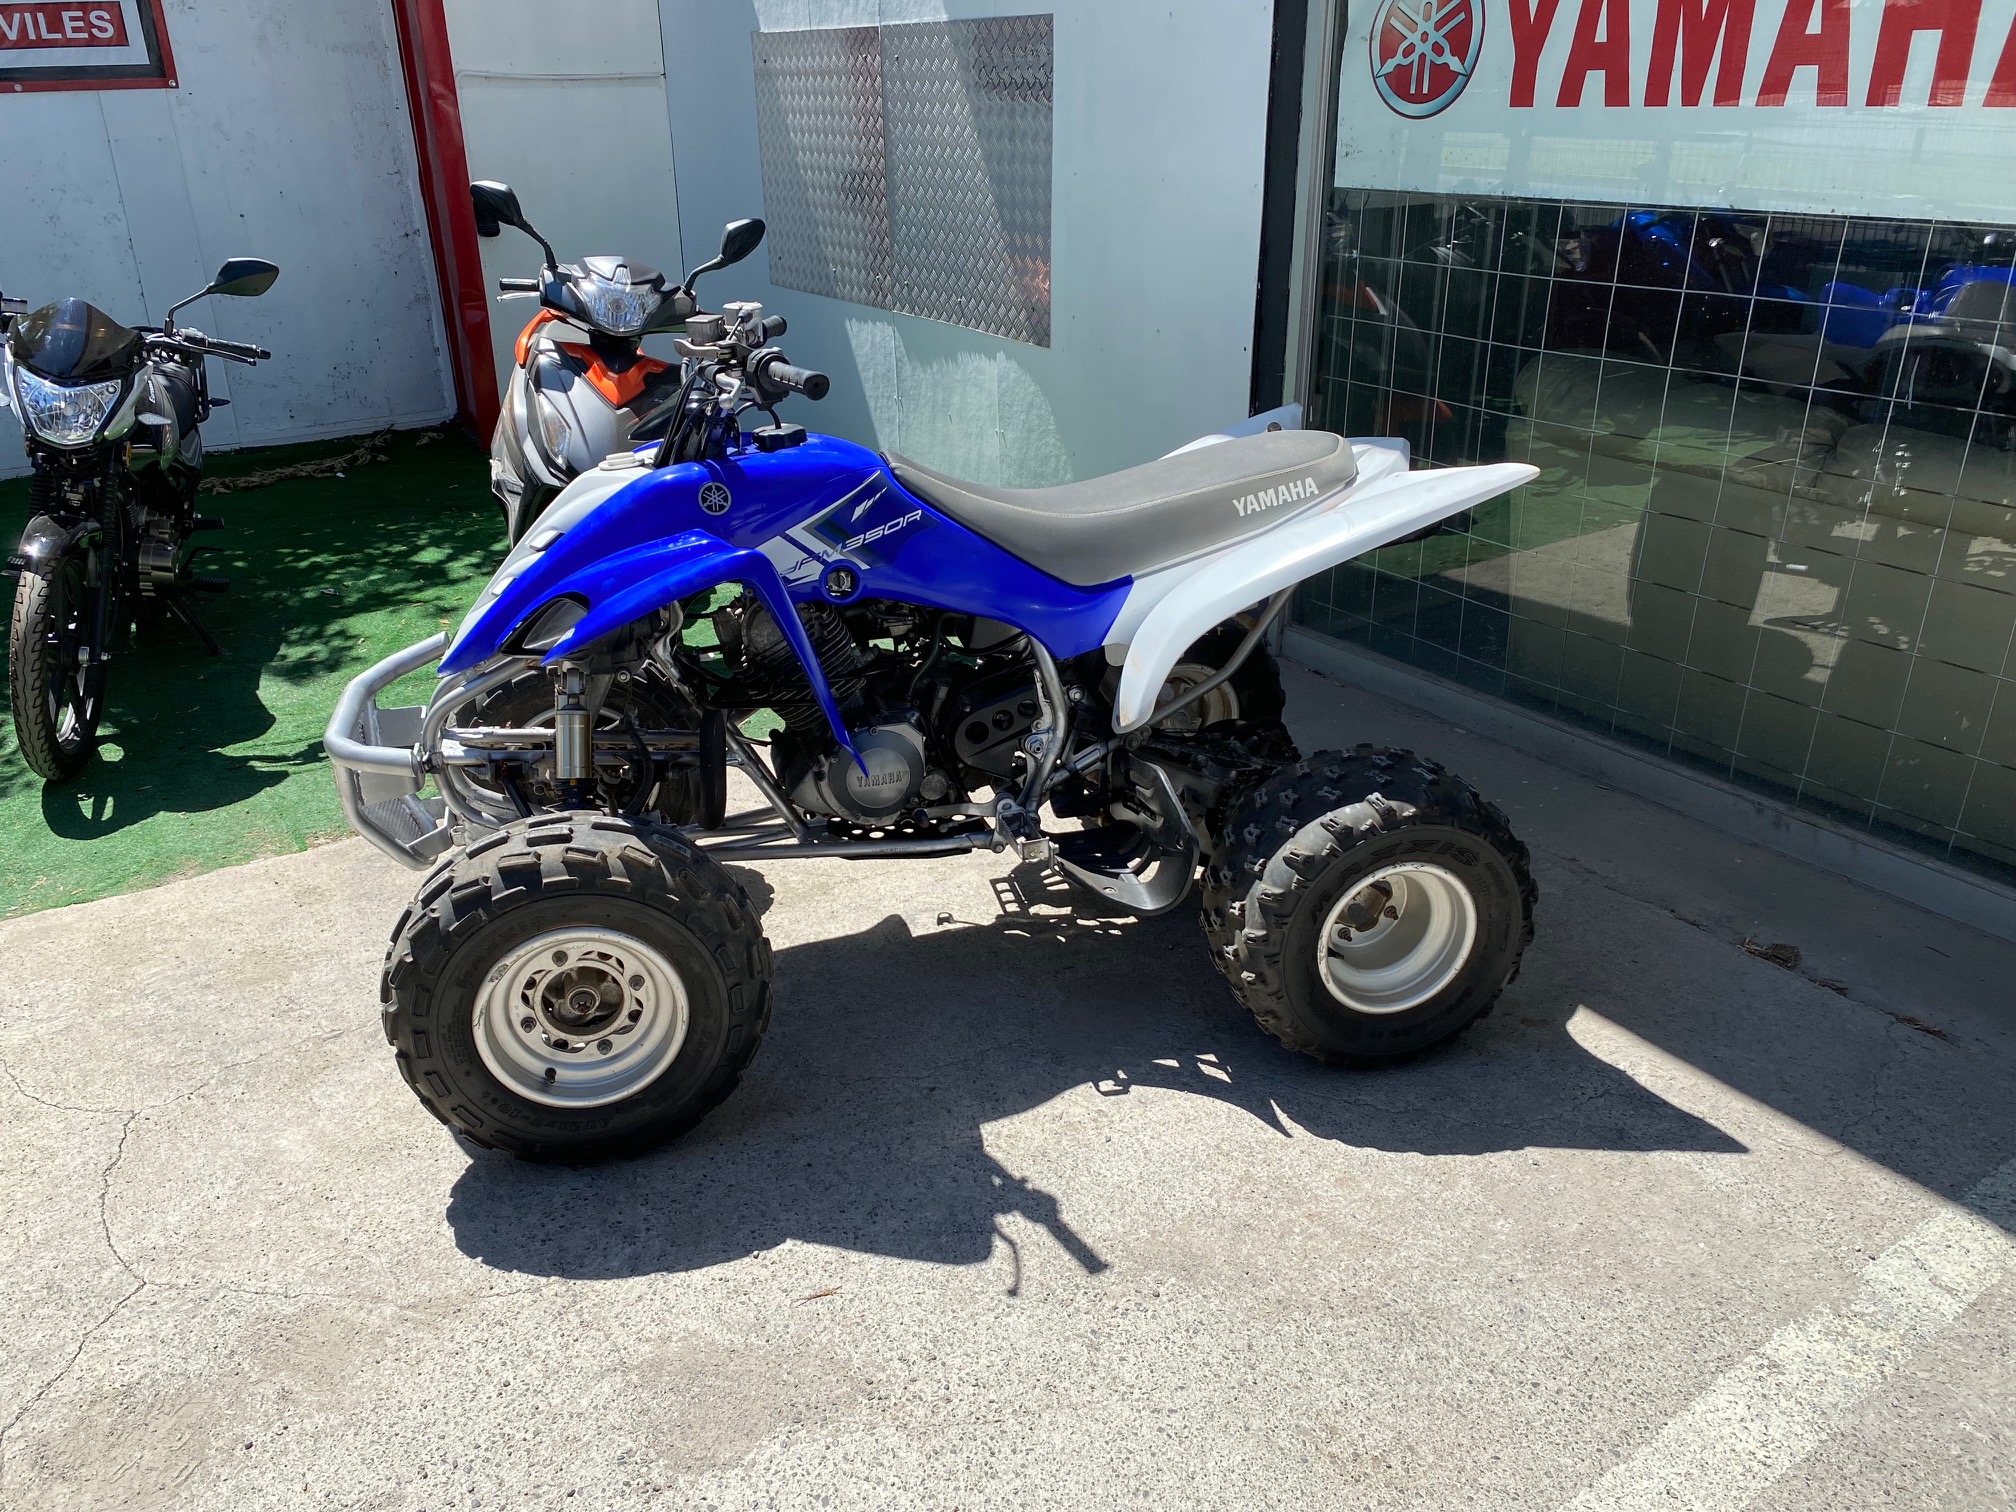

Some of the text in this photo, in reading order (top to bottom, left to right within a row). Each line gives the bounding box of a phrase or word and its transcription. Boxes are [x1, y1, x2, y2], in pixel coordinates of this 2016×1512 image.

[0, 10, 115, 41] VILES
[1509, 0, 2016, 107] YAMAH
[1232, 476, 1320, 517] YAMAHA
[856, 770, 903, 788] YAMAHA
[1309, 838, 1481, 926] MAXXIS
[455, 914, 549, 990] MAXXIS
